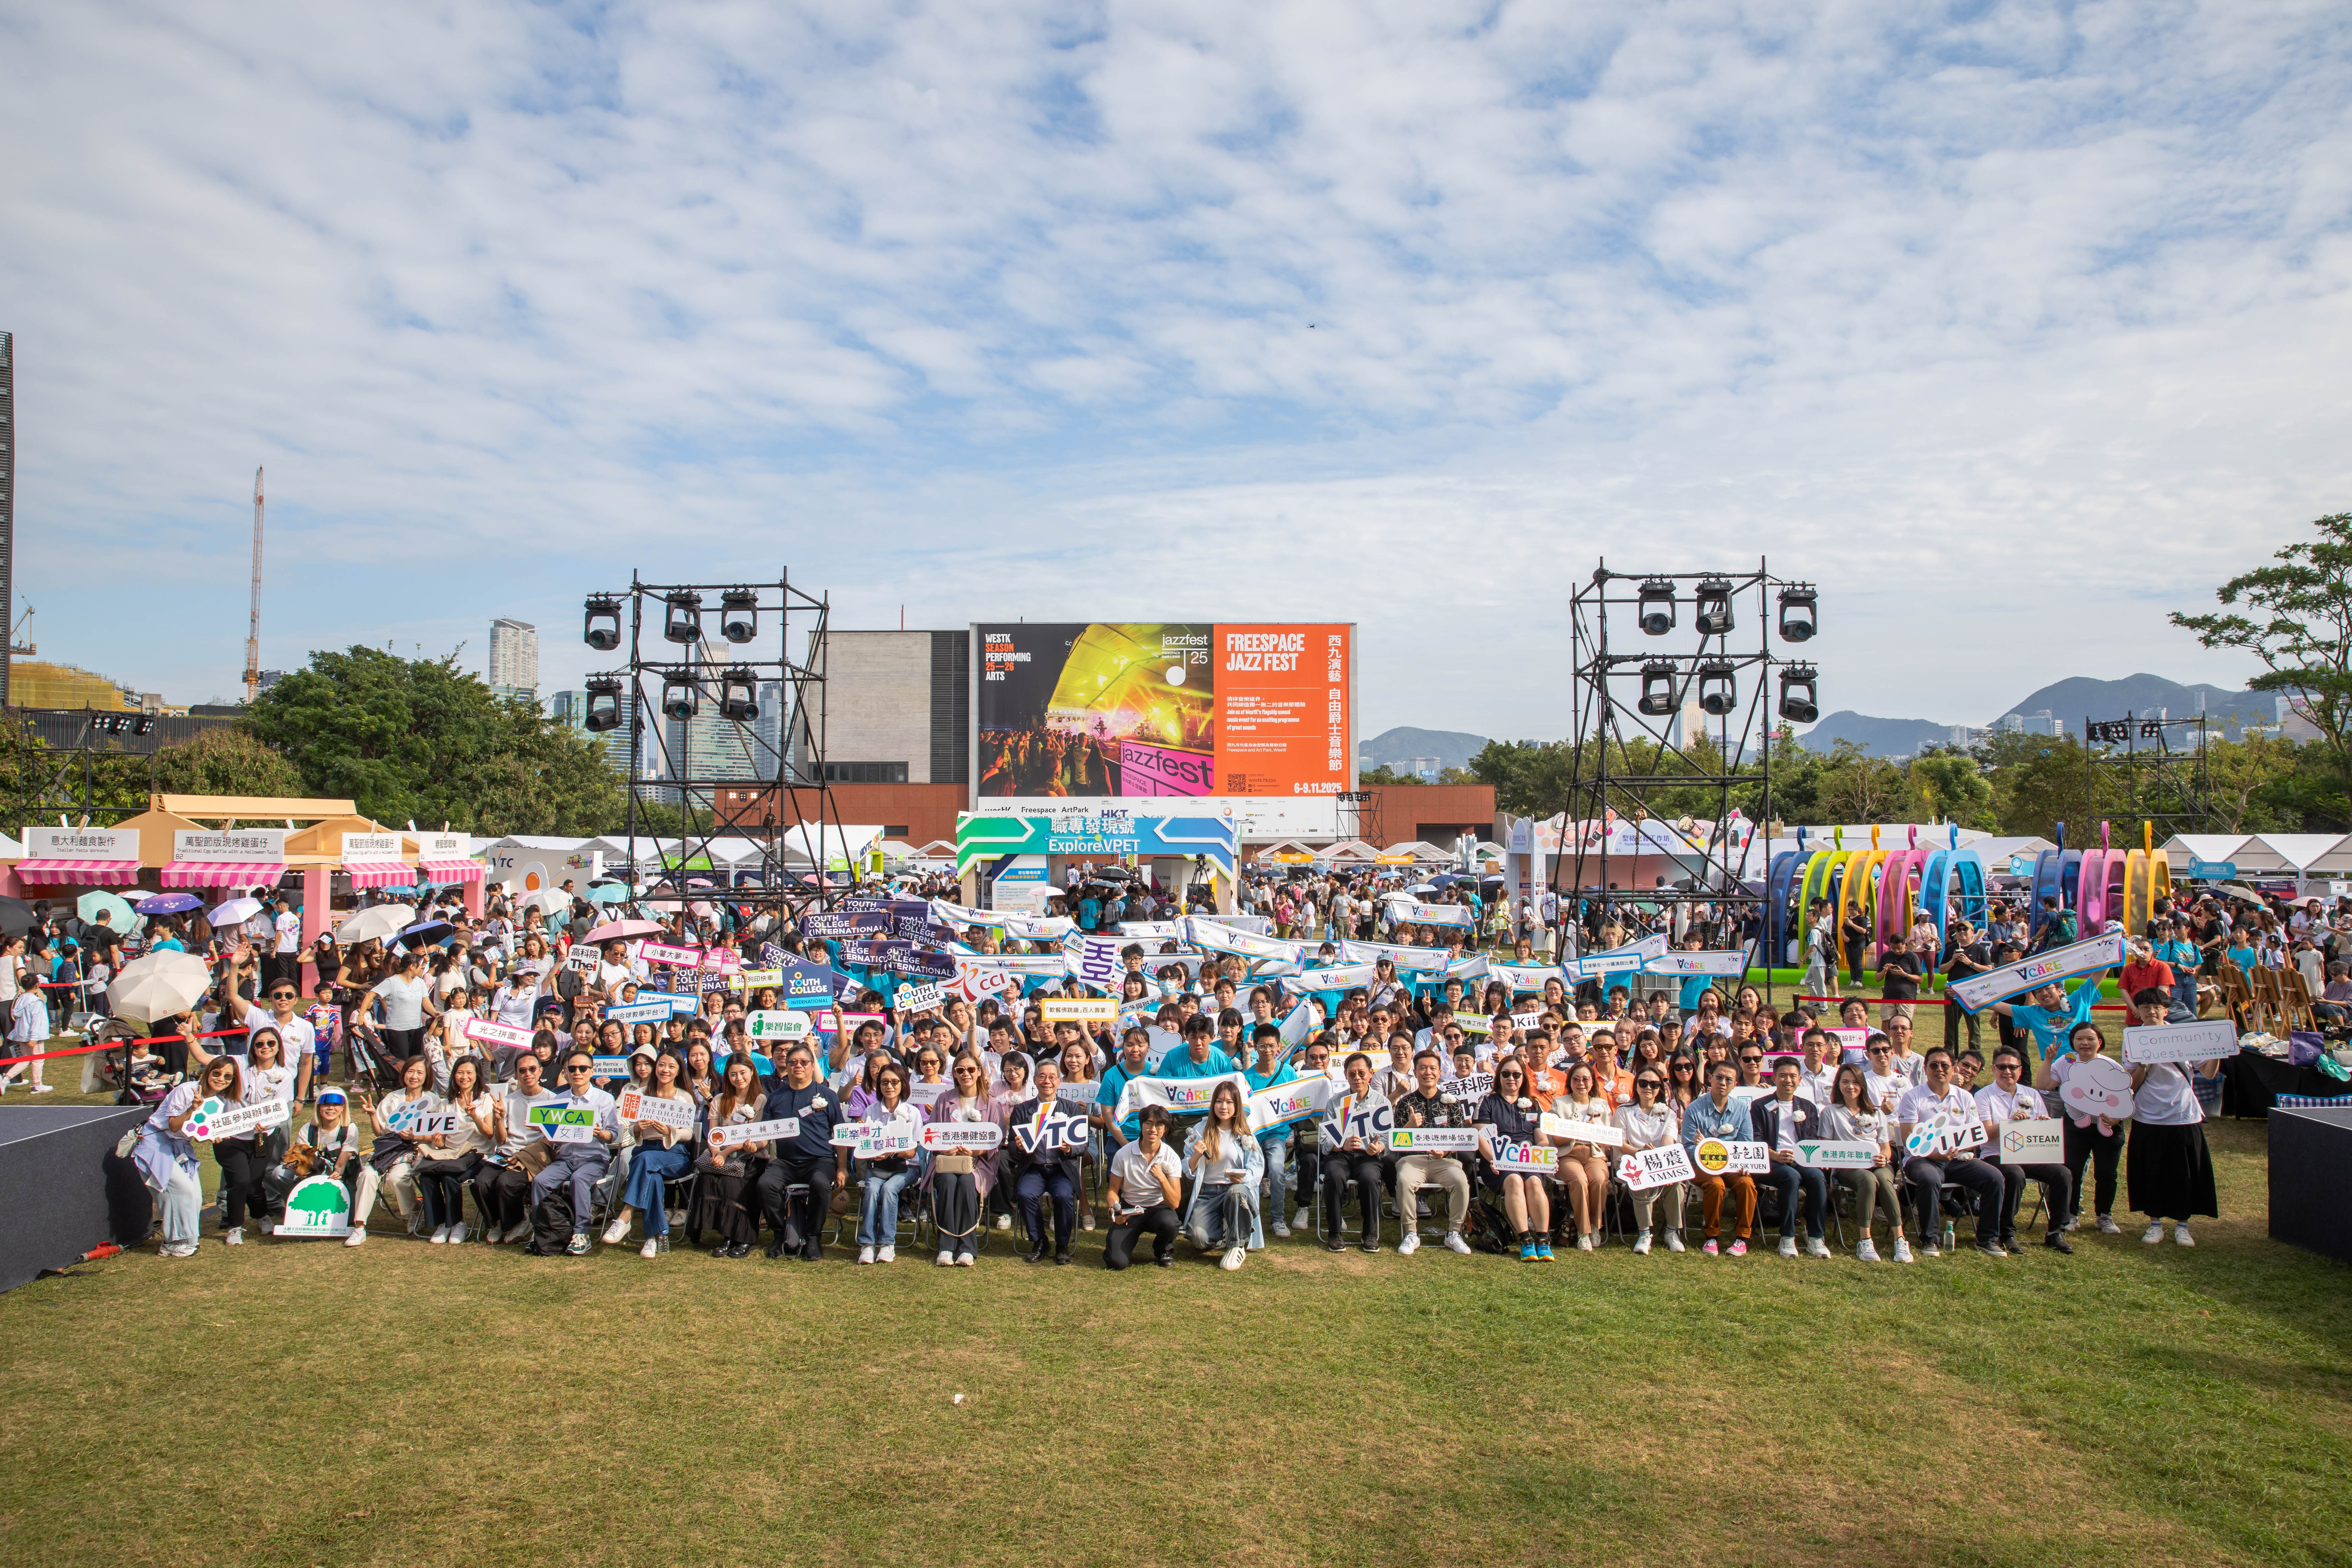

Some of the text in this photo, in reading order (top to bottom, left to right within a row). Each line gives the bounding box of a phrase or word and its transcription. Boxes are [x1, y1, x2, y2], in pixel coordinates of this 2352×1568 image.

[985, 634, 1011, 643] WESTK
[1162, 634, 1208, 648] jazzfest
[1227, 633, 1305, 652] FREESPACE
[985, 643, 1014, 652] SEASON
[986, 652, 1031, 662] PERFORMING
[1191, 651, 1208, 664] 25
[1227, 653, 1298, 671] JAZZ FEST
[986, 671, 1005, 680] ARTS
[1328, 635, 1342, 771] 西九演藝 自由爵士音樂節
[1122, 744, 1214, 790] jazzfest
[1122, 771, 1147, 787] FREESPACE
[1294, 782, 1342, 793] 6-9.11.2025
[1101, 809, 1129, 818] HKT
[1051, 818, 1135, 834] 職專發現號
[51, 835, 116, 846] 意大利麵食製作
[185, 837, 268, 848] 萬聖節版現烤雞蛋仔
[492, 849, 514, 868] VTC
[1412, 906, 1439, 918] VCARE
[808, 920, 850, 928] COLLEGE
[901, 917, 928, 930] YOUTH
[1026, 923, 1053, 933] VCARE
[809, 925, 888, 936] (INTERNATIONAL)
[899, 923, 936, 938] COLLEGE
[1228, 933, 1259, 950] VCARE
[2097, 939, 2115, 947] VTC
[571, 948, 598, 959] 高科院
[651, 949, 682, 959] 小薯大夢
[768, 946, 798, 964] YOUTH
[1728, 954, 1739, 962] VTC
[1583, 960, 1634, 969] 全港學生一分鐘演說比賽
[1677, 958, 1705, 969] VCARE
[2015, 959, 2064, 981] VCARE
[789, 978, 820, 987] YOUTH
[979, 973, 1005, 990] CCI
[1321, 974, 1351, 984] VCARE
[1513, 973, 1541, 984] VCARE
[789, 985, 827, 994] COLLEGE
[897, 986, 931, 999] YOUTH
[899, 990, 940, 1008] COLLEGE
[914, 1000, 937, 1011] 青年學院
[480, 1025, 516, 1041] 光之拼圖
[764, 1021, 802, 1032] 樂智協會
[2139, 1031, 2221, 1045] Community
[2141, 1049, 2183, 1060] Quest
[1443, 1074, 1494, 1096] 高科院
[1165, 1085, 1211, 1101] VCARE
[642, 1099, 694, 1114] 陳廷驊基金會
[1269, 1096, 1311, 1115] VCARE
[211, 1102, 282, 1129] 社區參與辦事處
[540, 1109, 586, 1124] YWCA
[639, 1113, 691, 1126] FOUNDATION
[657, 1108, 692, 1120] D.H.CHEN
[1324, 1095, 1390, 1145] VTC
[212, 1124, 241, 1137] Community
[242, 1116, 273, 1128] Engagement
[416, 1116, 455, 1133] IVE
[731, 1121, 795, 1137] 鄰舍輔導會
[1017, 1102, 1086, 1151] VTC
[559, 1126, 585, 1139] 女青
[836, 1126, 882, 1140] 職業專才
[942, 1130, 997, 1141] 香港傷健協會
[1940, 1125, 1984, 1151] IVE
[2026, 1135, 2060, 1143] STEAM
[860, 1136, 909, 1151] 連繫社區
[1490, 1136, 1559, 1165] VCARE
[1729, 1145, 1764, 1159] 嗇色園
[1822, 1150, 1872, 1159] 香港青年聯會
[1644, 1149, 1684, 1171] 楊震
[1649, 1168, 1689, 1182] YMMSS
